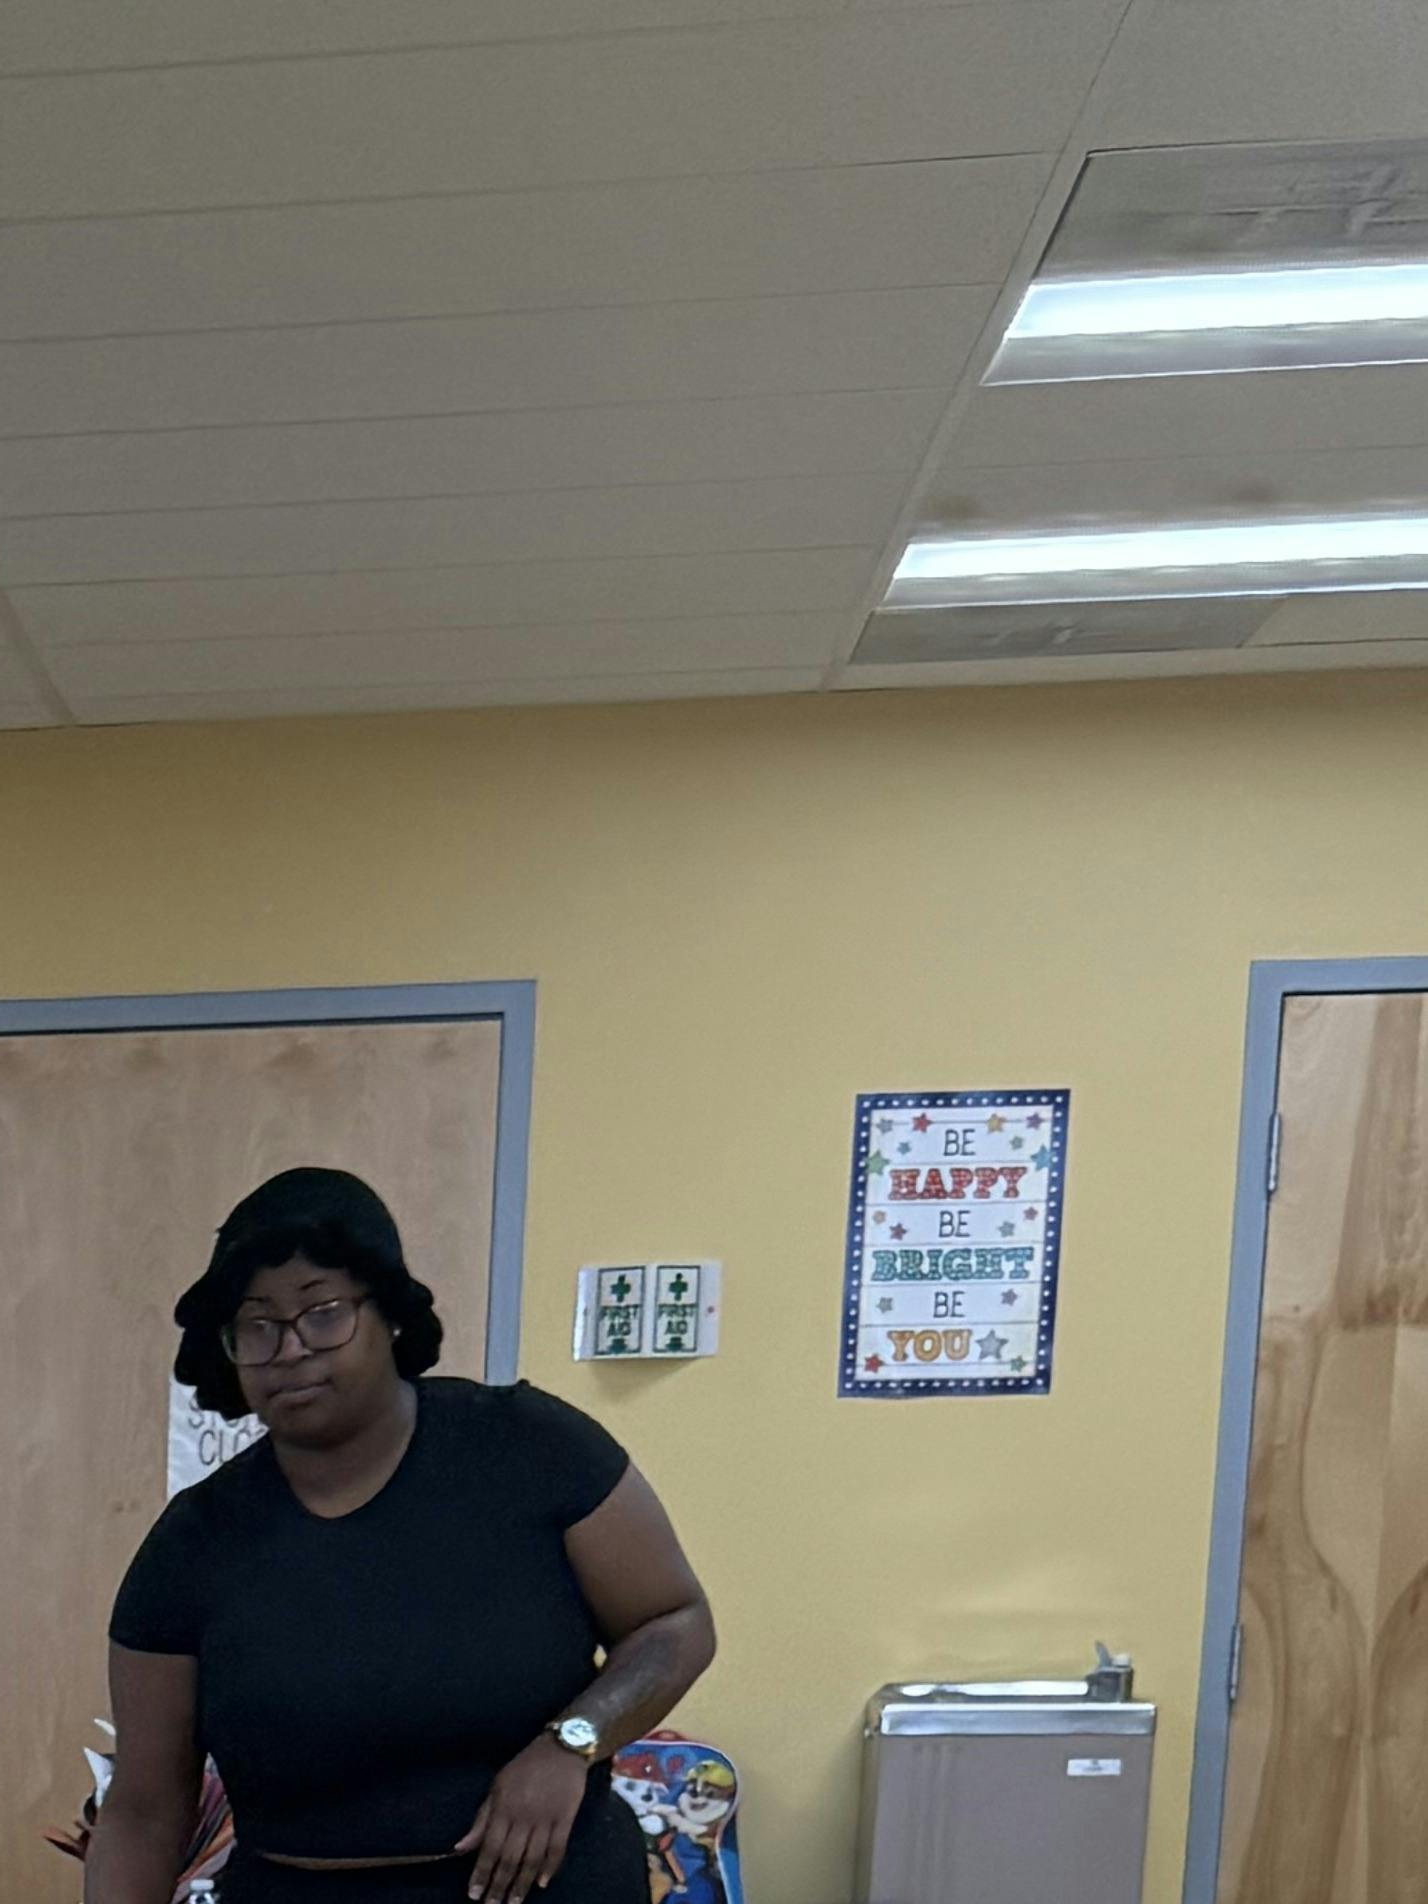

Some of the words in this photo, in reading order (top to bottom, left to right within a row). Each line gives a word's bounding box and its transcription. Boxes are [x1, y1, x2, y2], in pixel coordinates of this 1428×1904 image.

[943, 1128, 976, 1156] BE
[888, 1167, 1027, 1201] HAPPY
[938, 1210, 971, 1238] BE
[870, 1246, 1035, 1282] BRIGHT
[933, 1291, 966, 1318] BE
[607, 1321, 631, 1337] AID
[665, 1320, 688, 1336] AID
[887, 1329, 973, 1362] YOU
